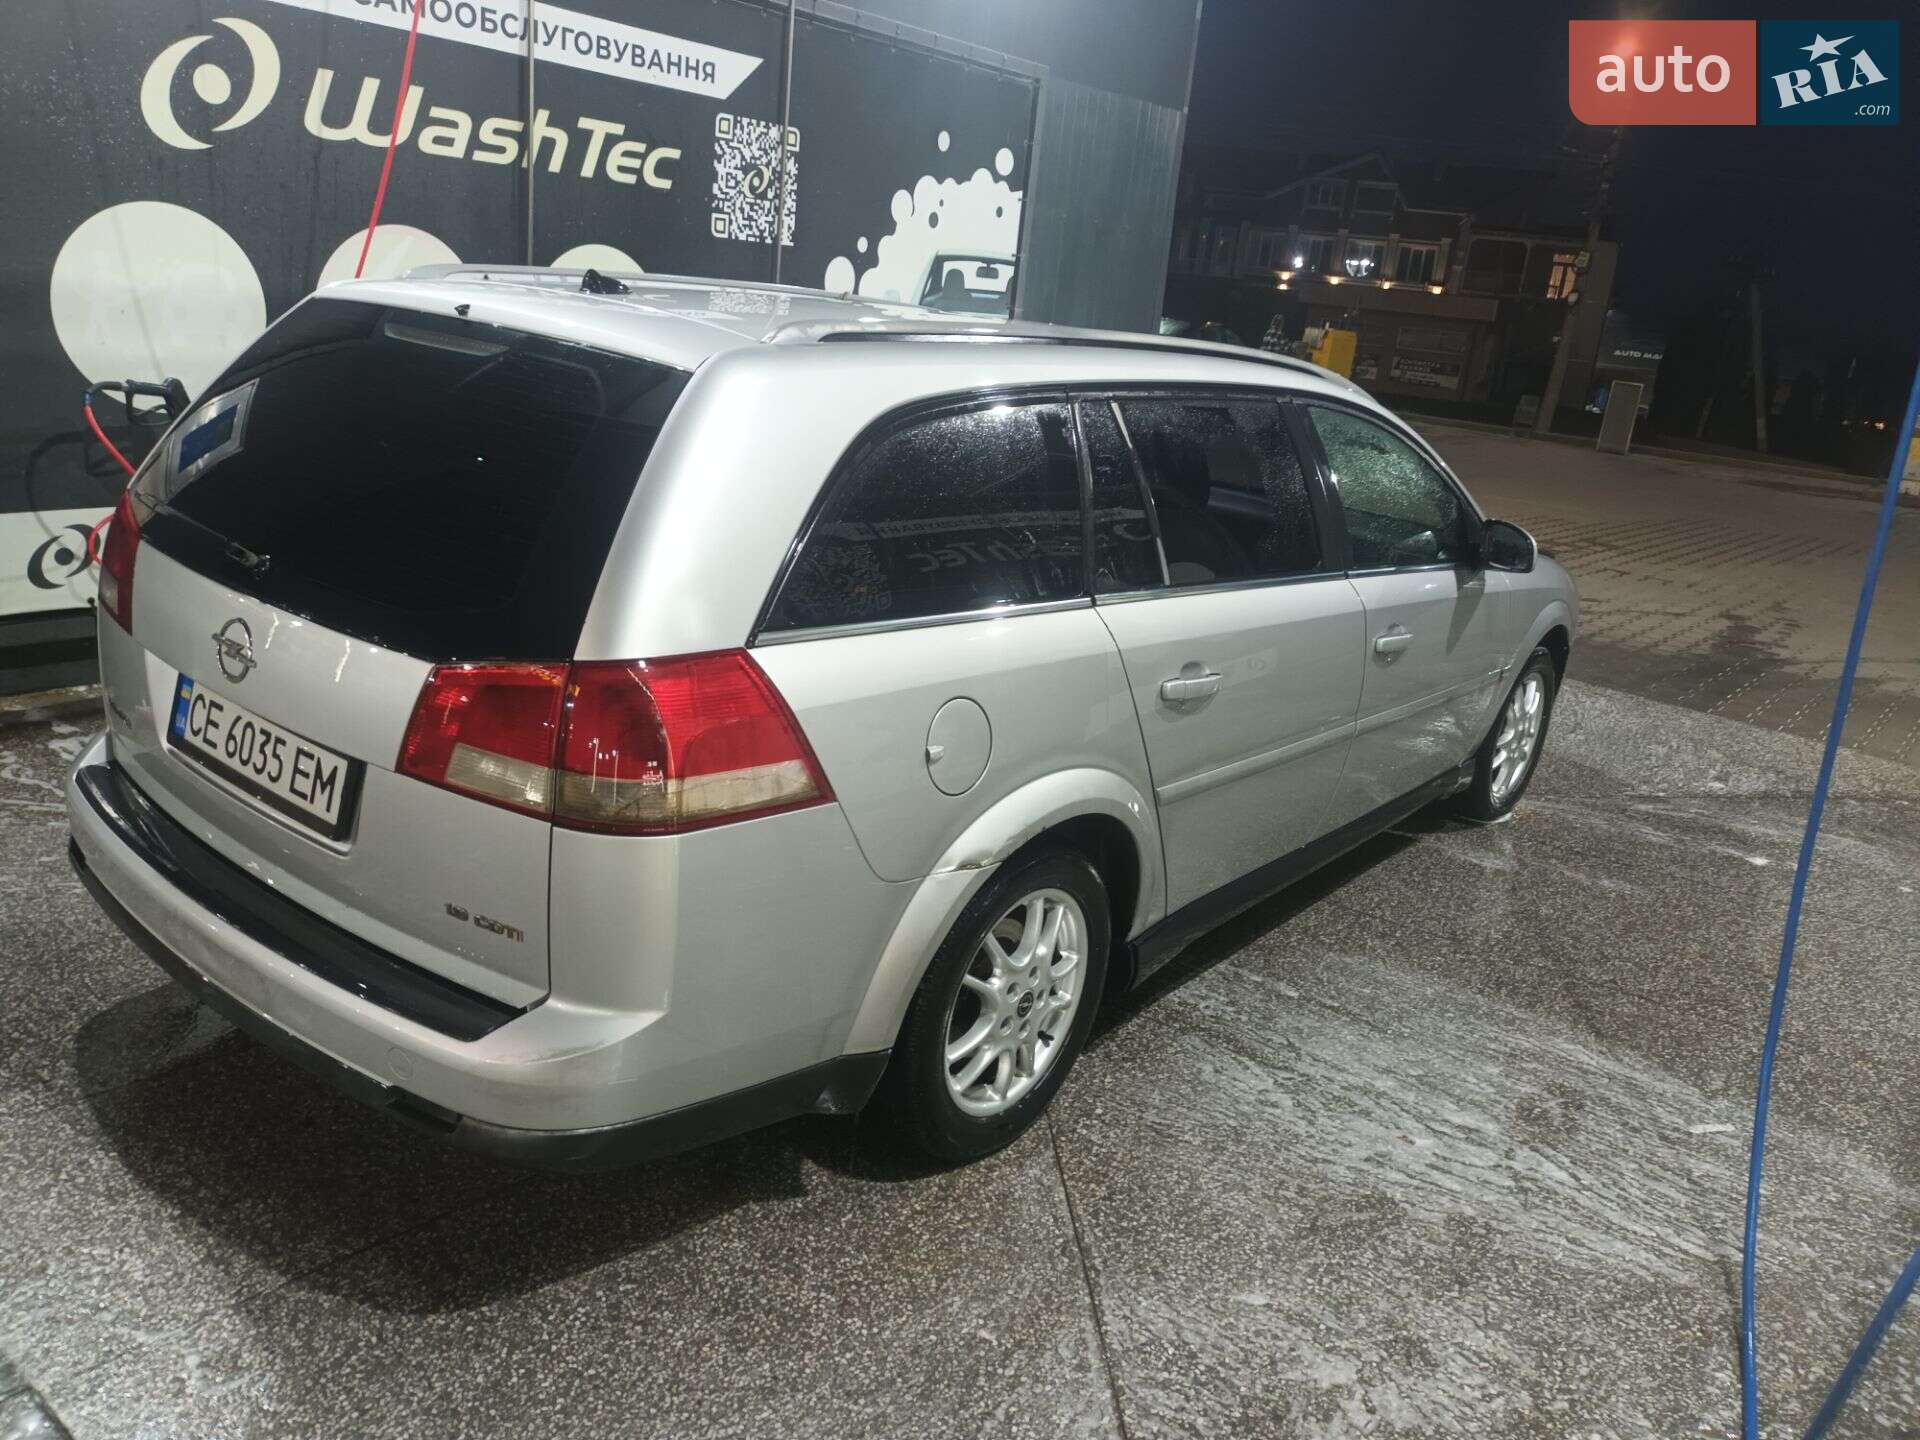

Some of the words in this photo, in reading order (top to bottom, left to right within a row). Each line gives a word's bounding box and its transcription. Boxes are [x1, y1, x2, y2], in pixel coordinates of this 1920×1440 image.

[355, 0, 716, 84] МООБСЛУГОВУВАННЯ
[188, 693, 224, 749] CE
[224, 715, 287, 783] 6035
[289, 747, 340, 813] EM
